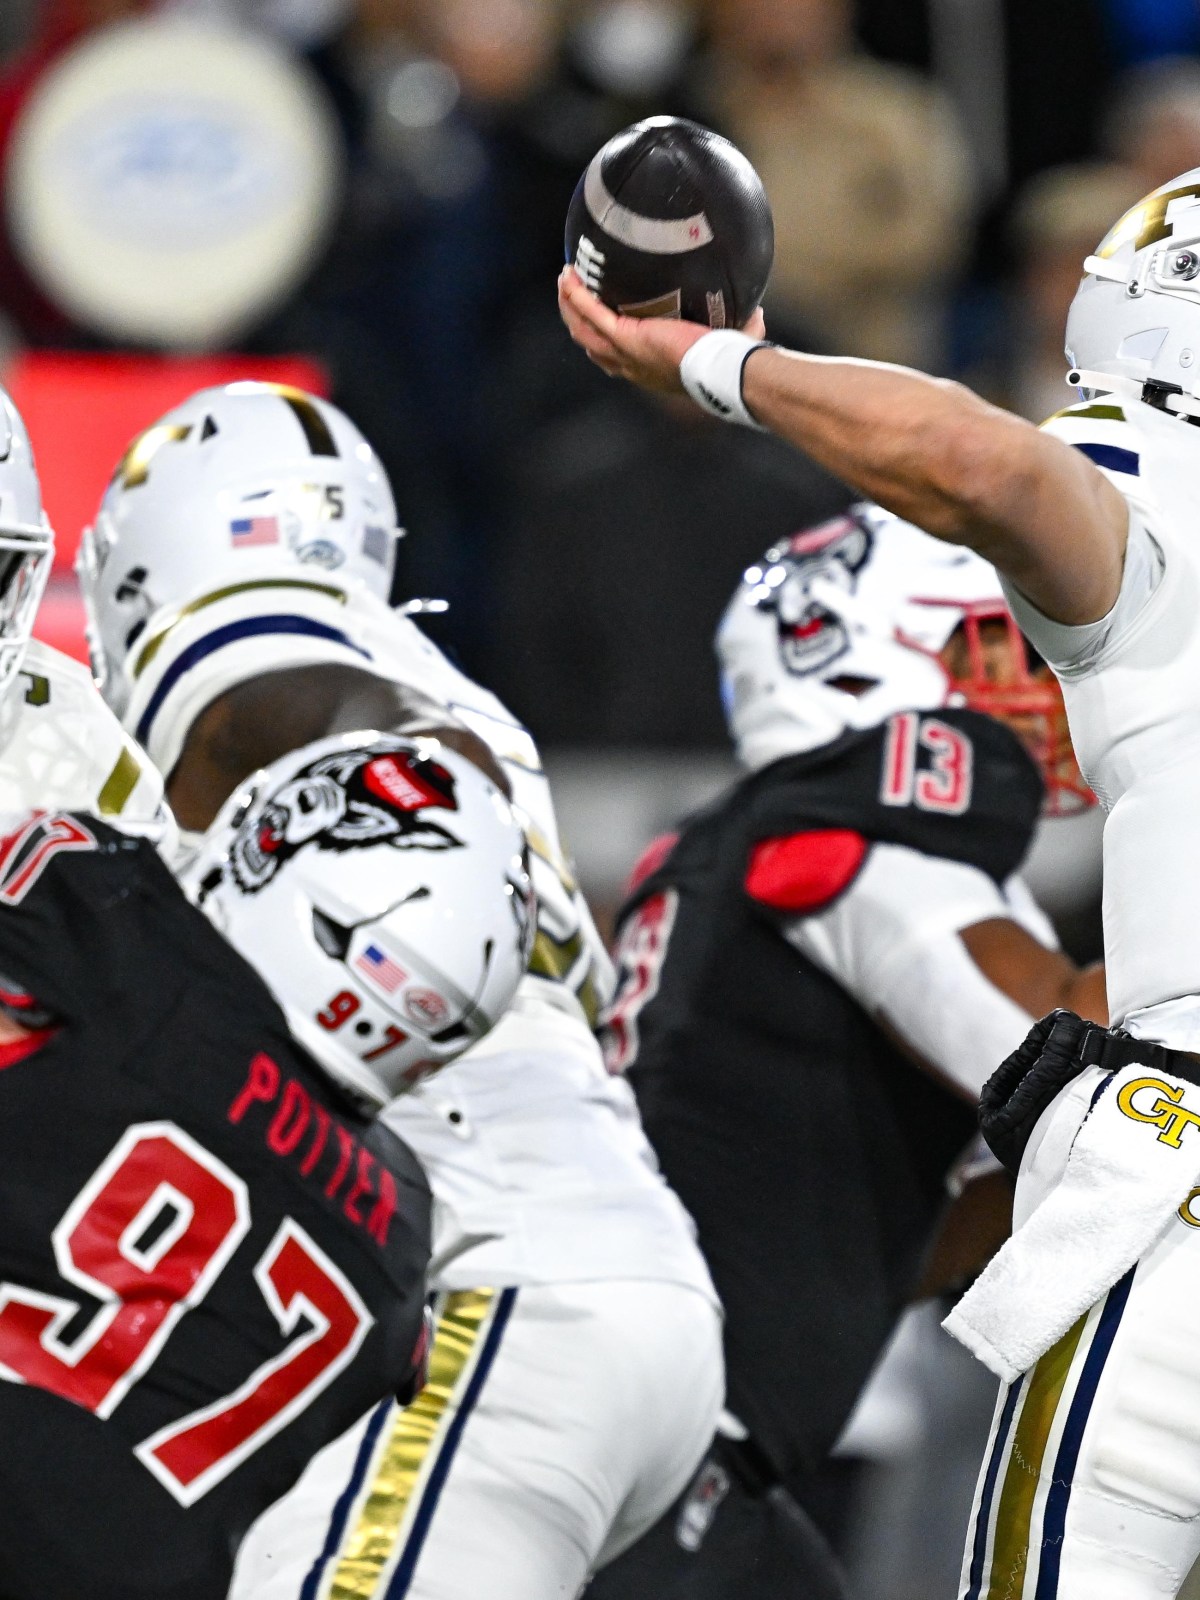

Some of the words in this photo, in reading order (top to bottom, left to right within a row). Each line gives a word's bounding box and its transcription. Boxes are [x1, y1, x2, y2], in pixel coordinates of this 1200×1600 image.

[879, 711, 974, 817] 13
[226, 1051, 399, 1248] POTTER
[0, 1120, 376, 1508] 97
